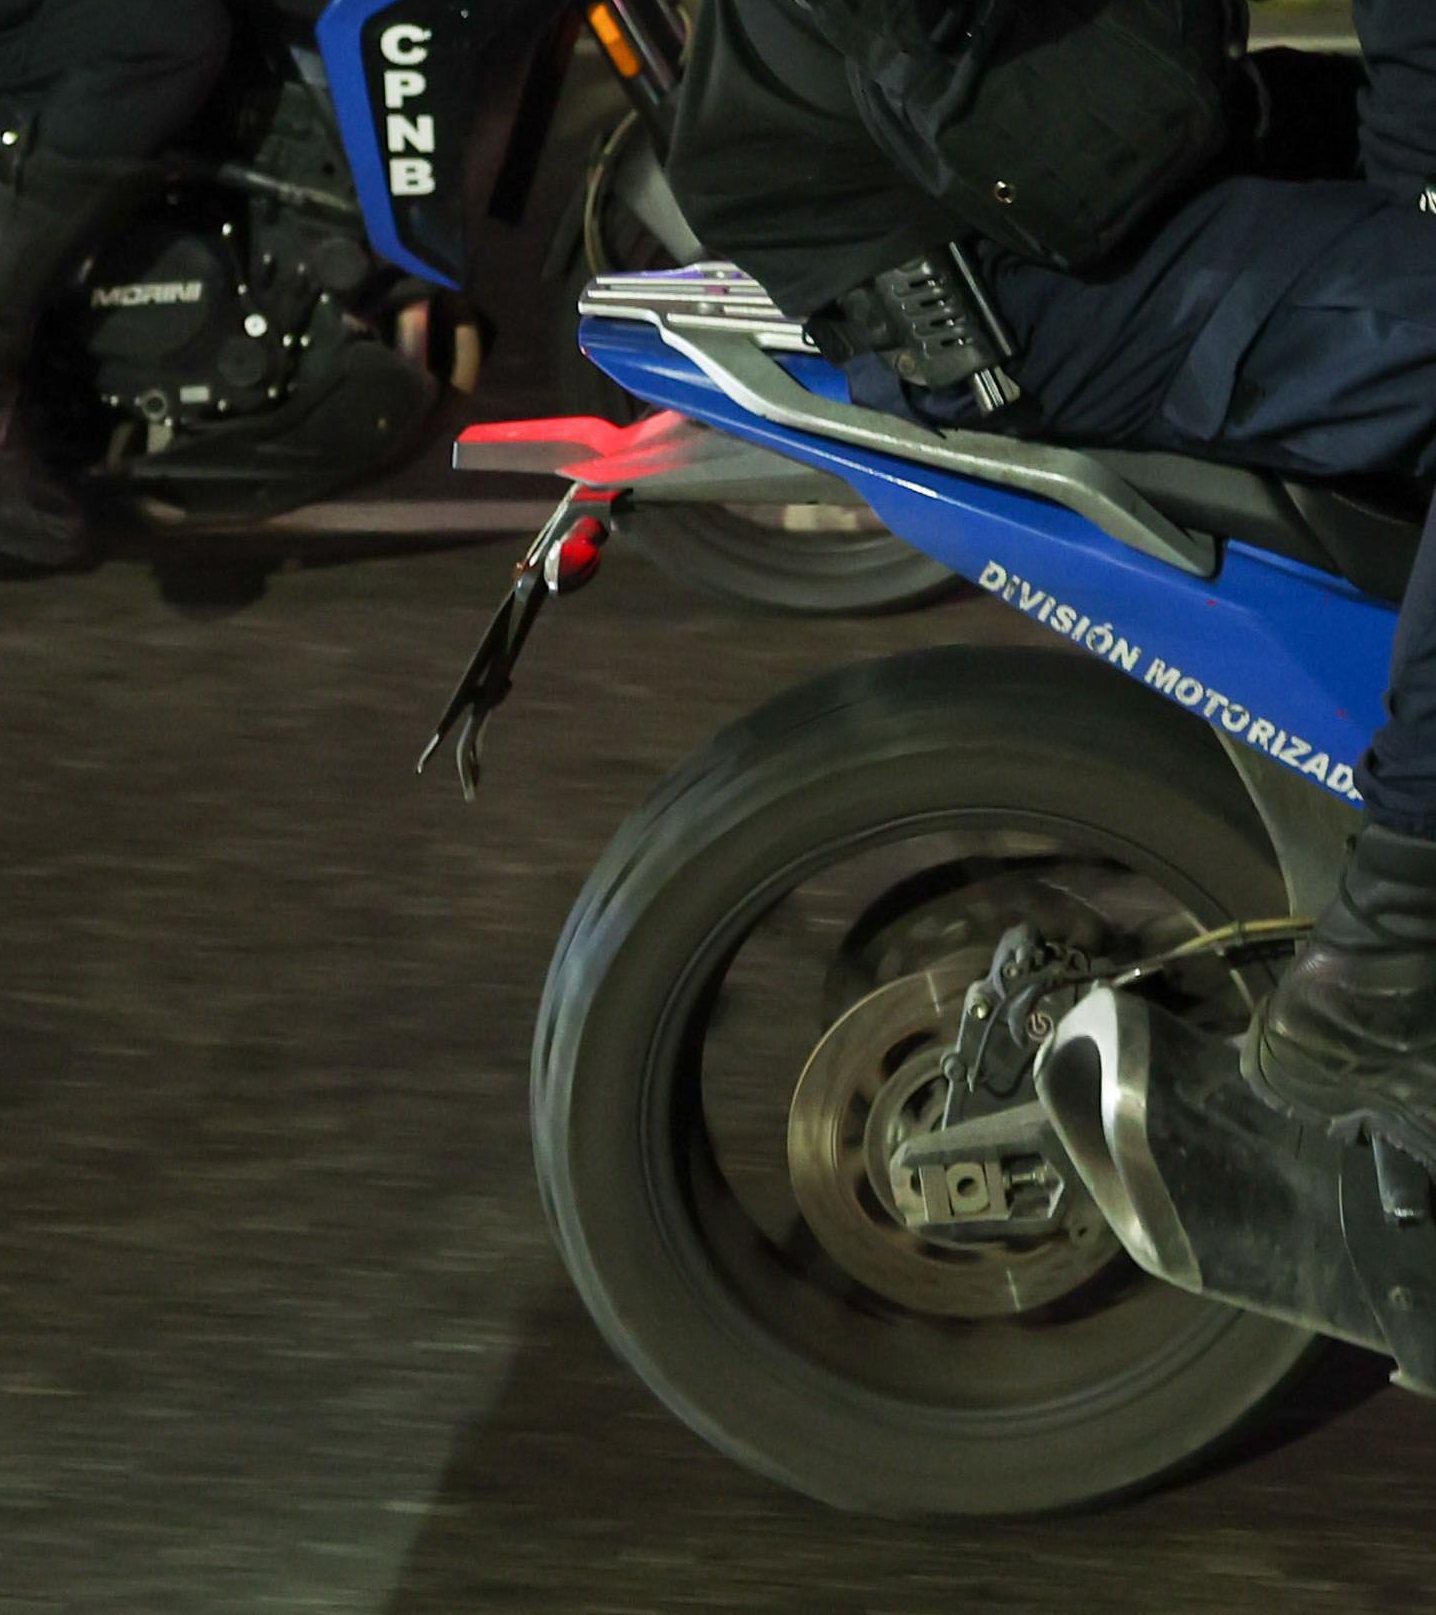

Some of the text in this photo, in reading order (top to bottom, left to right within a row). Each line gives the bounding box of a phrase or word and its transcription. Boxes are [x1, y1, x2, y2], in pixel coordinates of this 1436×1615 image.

[379, 23, 436, 198] CPNB
[91, 280, 203, 307] MORINI
[978, 559, 1142, 672] DIVISIÓN
